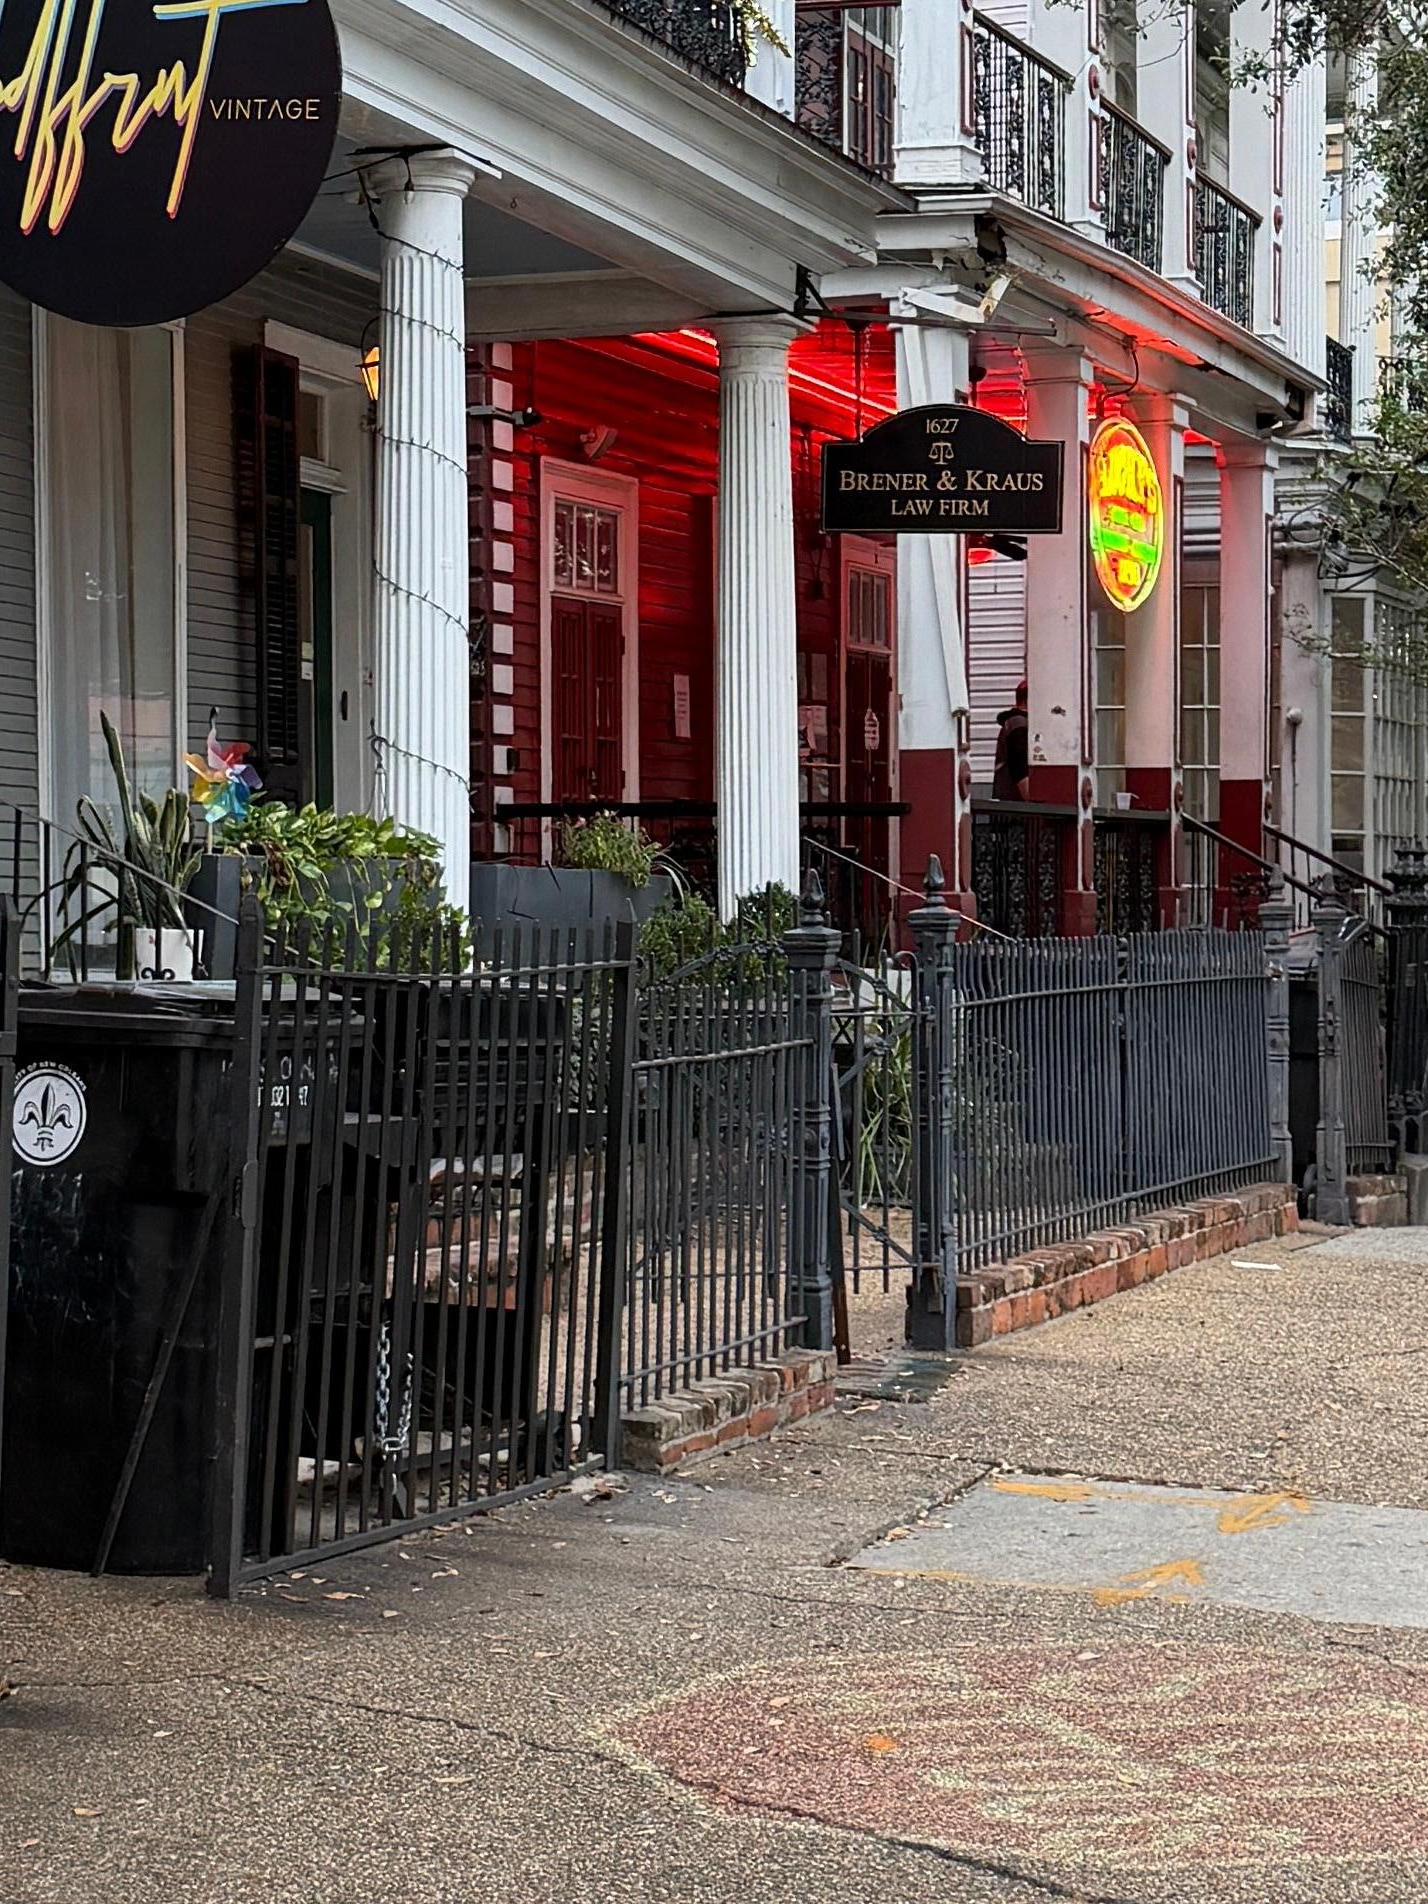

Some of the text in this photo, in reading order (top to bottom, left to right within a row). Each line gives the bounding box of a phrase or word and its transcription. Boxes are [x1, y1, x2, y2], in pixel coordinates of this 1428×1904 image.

[209, 98, 321, 121] VINTAGE
[925, 418, 960, 435] 1627
[838, 470, 1044, 492] BRENER & KRAUS
[891, 499, 990, 517] LAW FIRM
